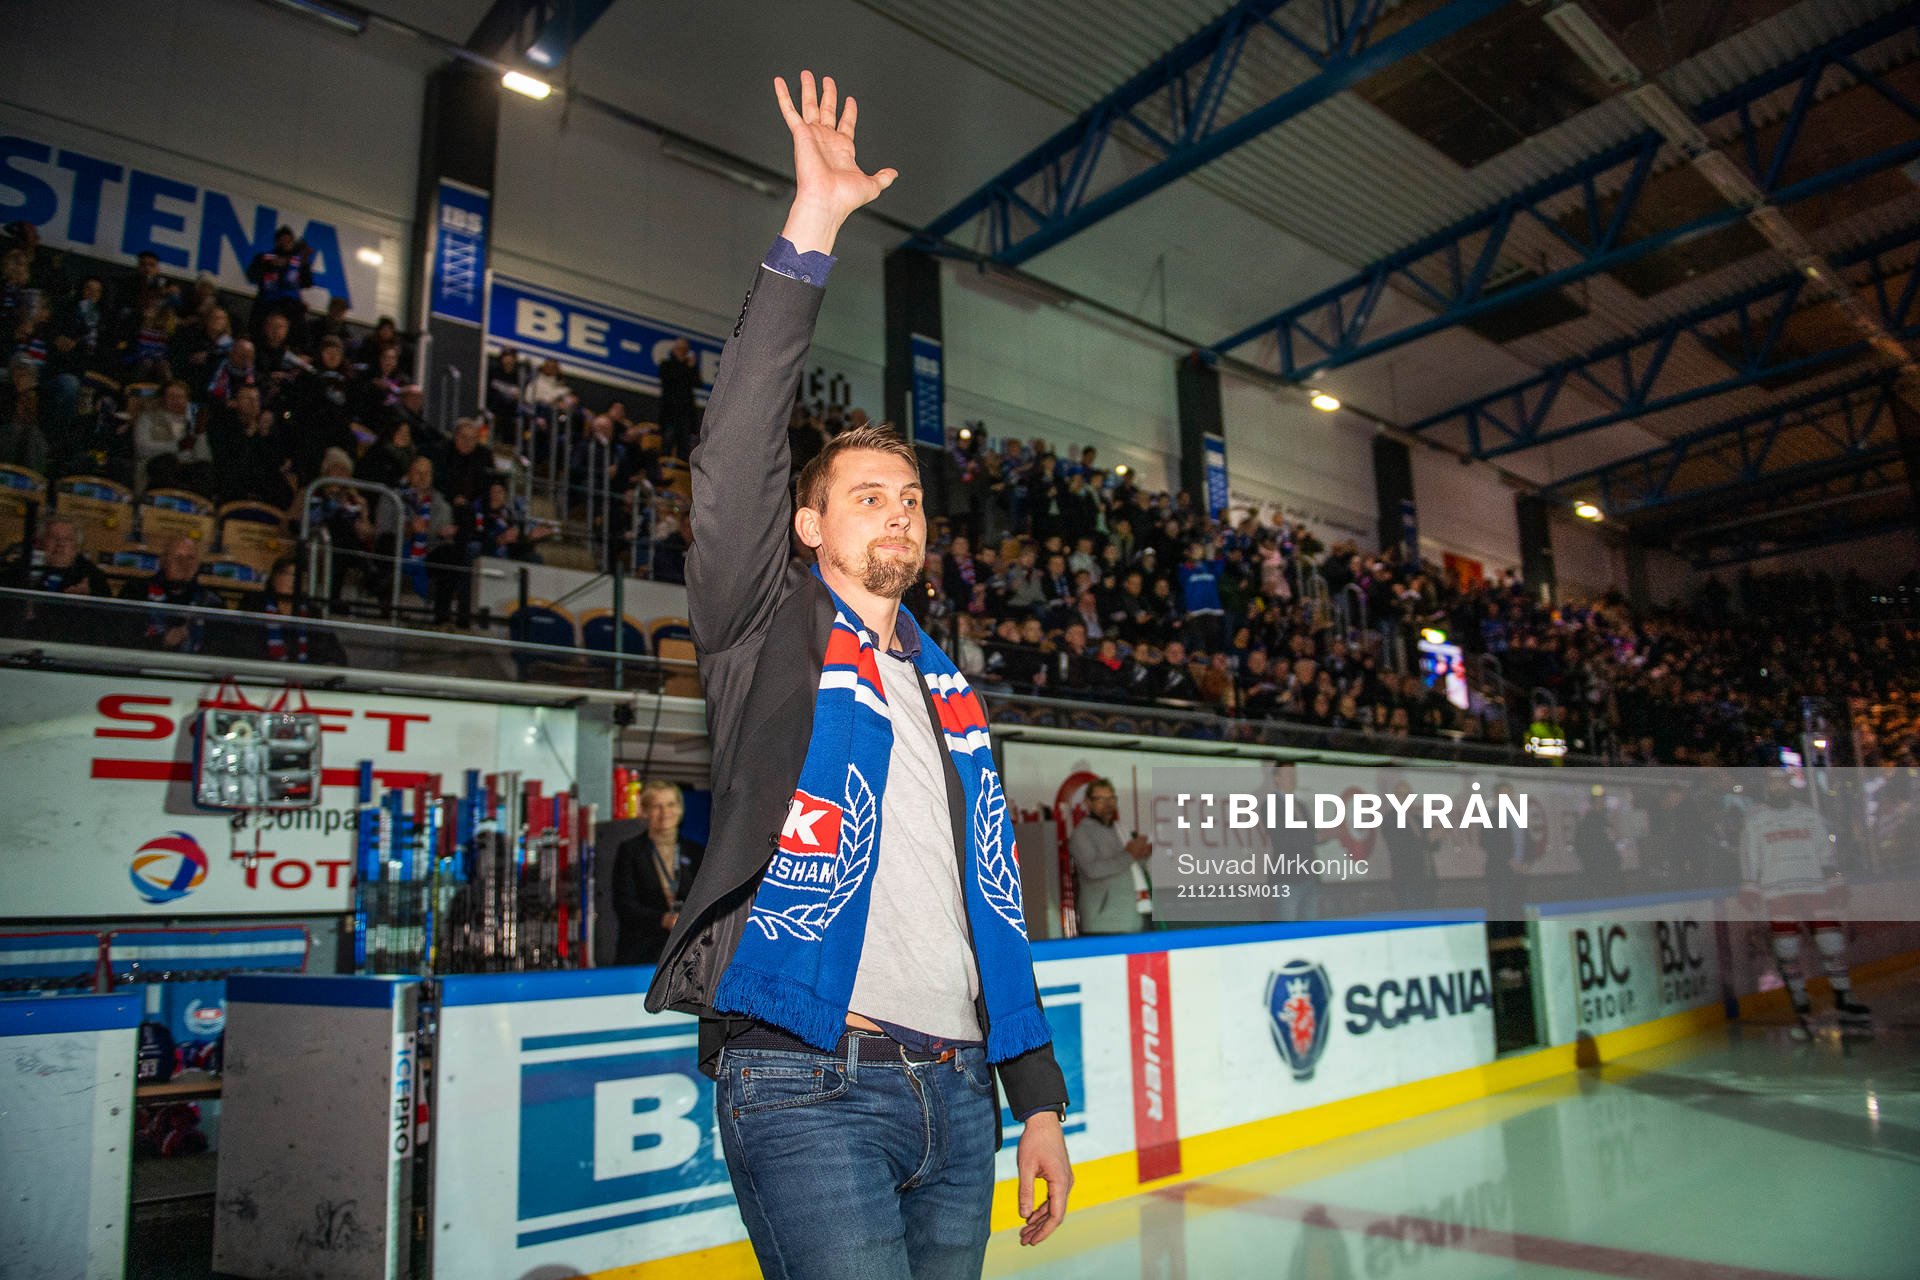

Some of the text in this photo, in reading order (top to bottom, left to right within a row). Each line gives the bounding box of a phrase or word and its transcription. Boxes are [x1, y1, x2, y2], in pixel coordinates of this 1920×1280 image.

[0, 135, 352, 309] STENA
[94, 694, 430, 752] SFT
[232, 852, 352, 889] TOT
[1576, 923, 1632, 991] BJC
[1655, 916, 1703, 975] BJC
[1345, 968, 1493, 1035] SCANIA
[395, 1049, 412, 1154] ICEPRO
